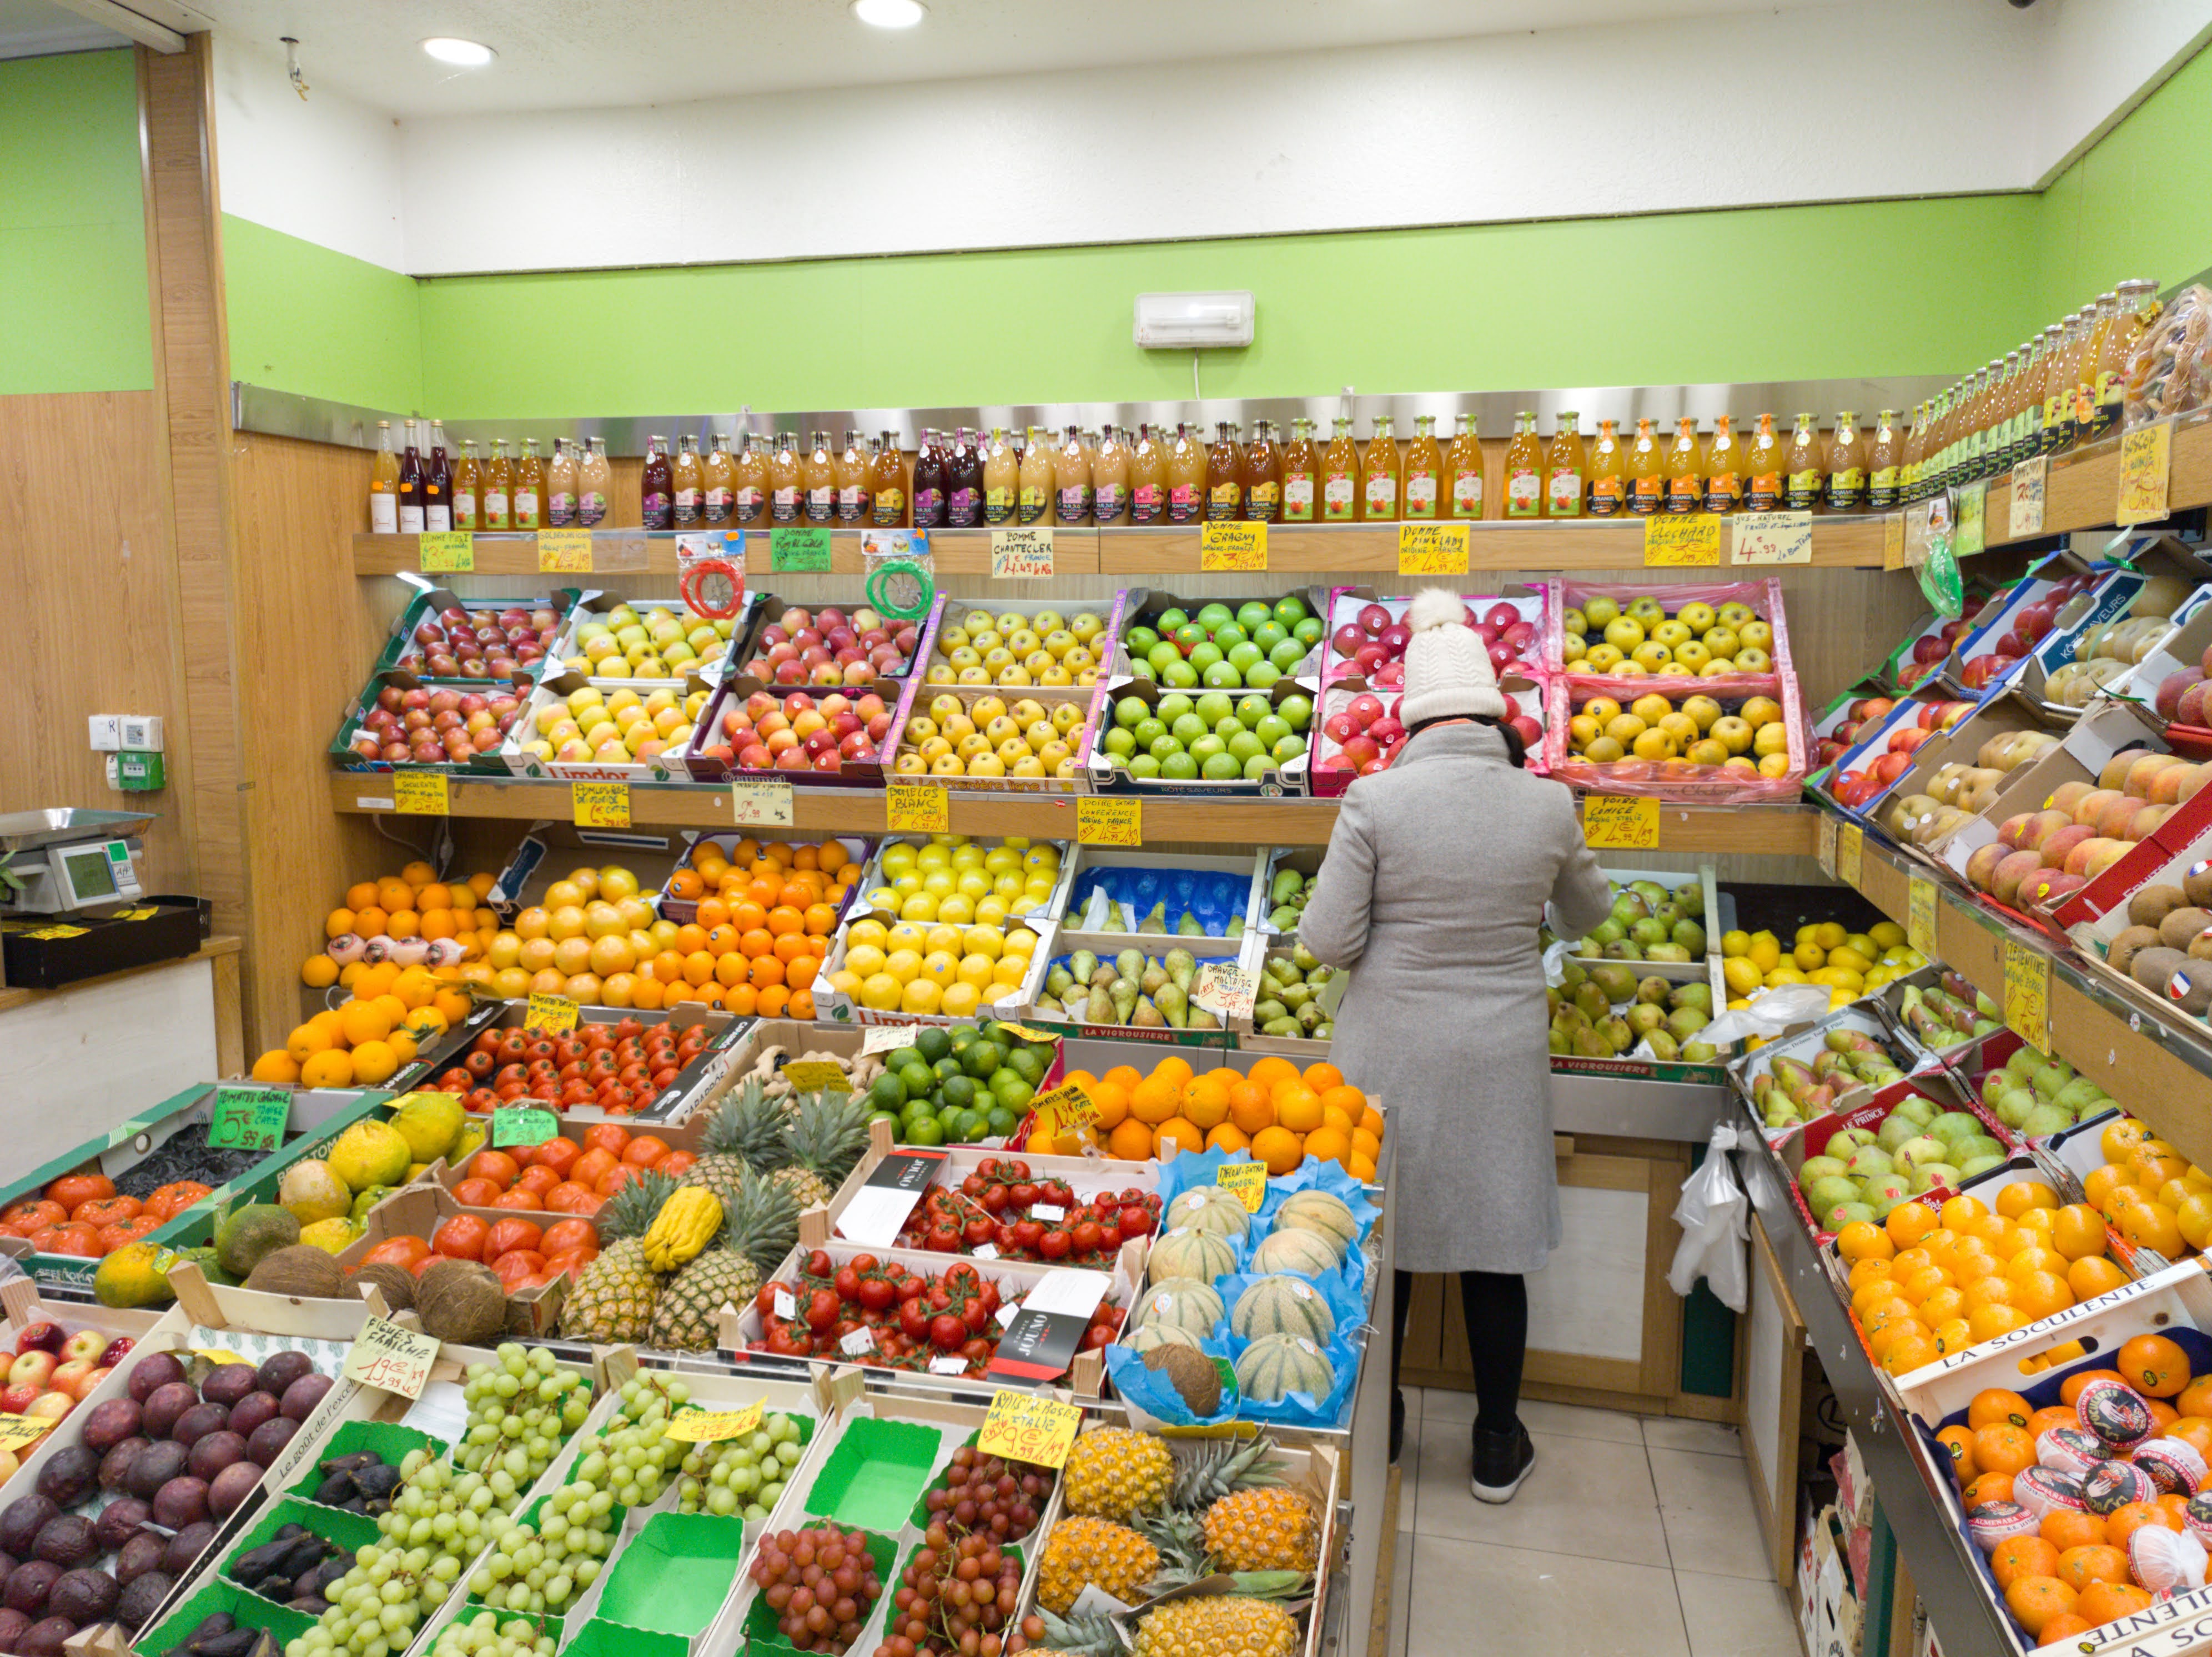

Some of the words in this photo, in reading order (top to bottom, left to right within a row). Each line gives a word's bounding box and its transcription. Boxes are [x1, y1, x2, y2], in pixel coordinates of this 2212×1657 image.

[1206, 522, 1244, 533] POMME
[1653, 515, 1698, 528] POMME
[785, 529, 814, 538] POMME
[1006, 531, 1037, 542] POMME
[1403, 525, 1442, 540] POMME
[1650, 525, 1716, 539] CLOCHARD
[993, 543, 1052, 555] CHANTECLER
[1433, 545, 1465, 554] FRANCE
[108, 720, 115, 733] R
[547, 767, 630, 779] Limdor
[918, 778, 937, 789] La
[941, 779, 1006, 791] Première
[1009, 780, 1040, 793] ligne
[890, 787, 938, 800] POMELOS
[896, 799, 938, 810] BLANC
[1084, 800, 1113, 809] POIRE
[1080, 809, 1137, 817] CONFERENCE
[1590, 806, 1635, 817] COMICE
[2005, 942, 2046, 978] CLEMENTINE
[1208, 965, 1239, 976] ORANGE
[1829, 1018, 1844, 1031] Pilat
[1100, 1029, 1171, 1041] VIGROUSIERE
[1564, 1060, 1649, 1075] VIGROUSIERE
[1842, 1121, 1853, 1132] LE
[1854, 1107, 1885, 1127] PRINCE
[898, 1158, 924, 1188] JOUNO
[1943, 1349, 1978, 1369] LA
[1990, 1278, 2155, 1350] SOCULENTE
[1014, 1319, 1029, 1344] TOMATE
[1018, 1313, 1048, 1357] JOUNO
[366, 1331, 431, 1360] FRAICHE
[1012, 1415, 1055, 1432] ITALIE
[279, 1462, 293, 1478] Le
[292, 1432, 314, 1464] goût
[315, 1414, 326, 1434] de
[1974, 1517, 2017, 1527] ALMENARA
[182, 1540, 222, 1590] TOMATE
